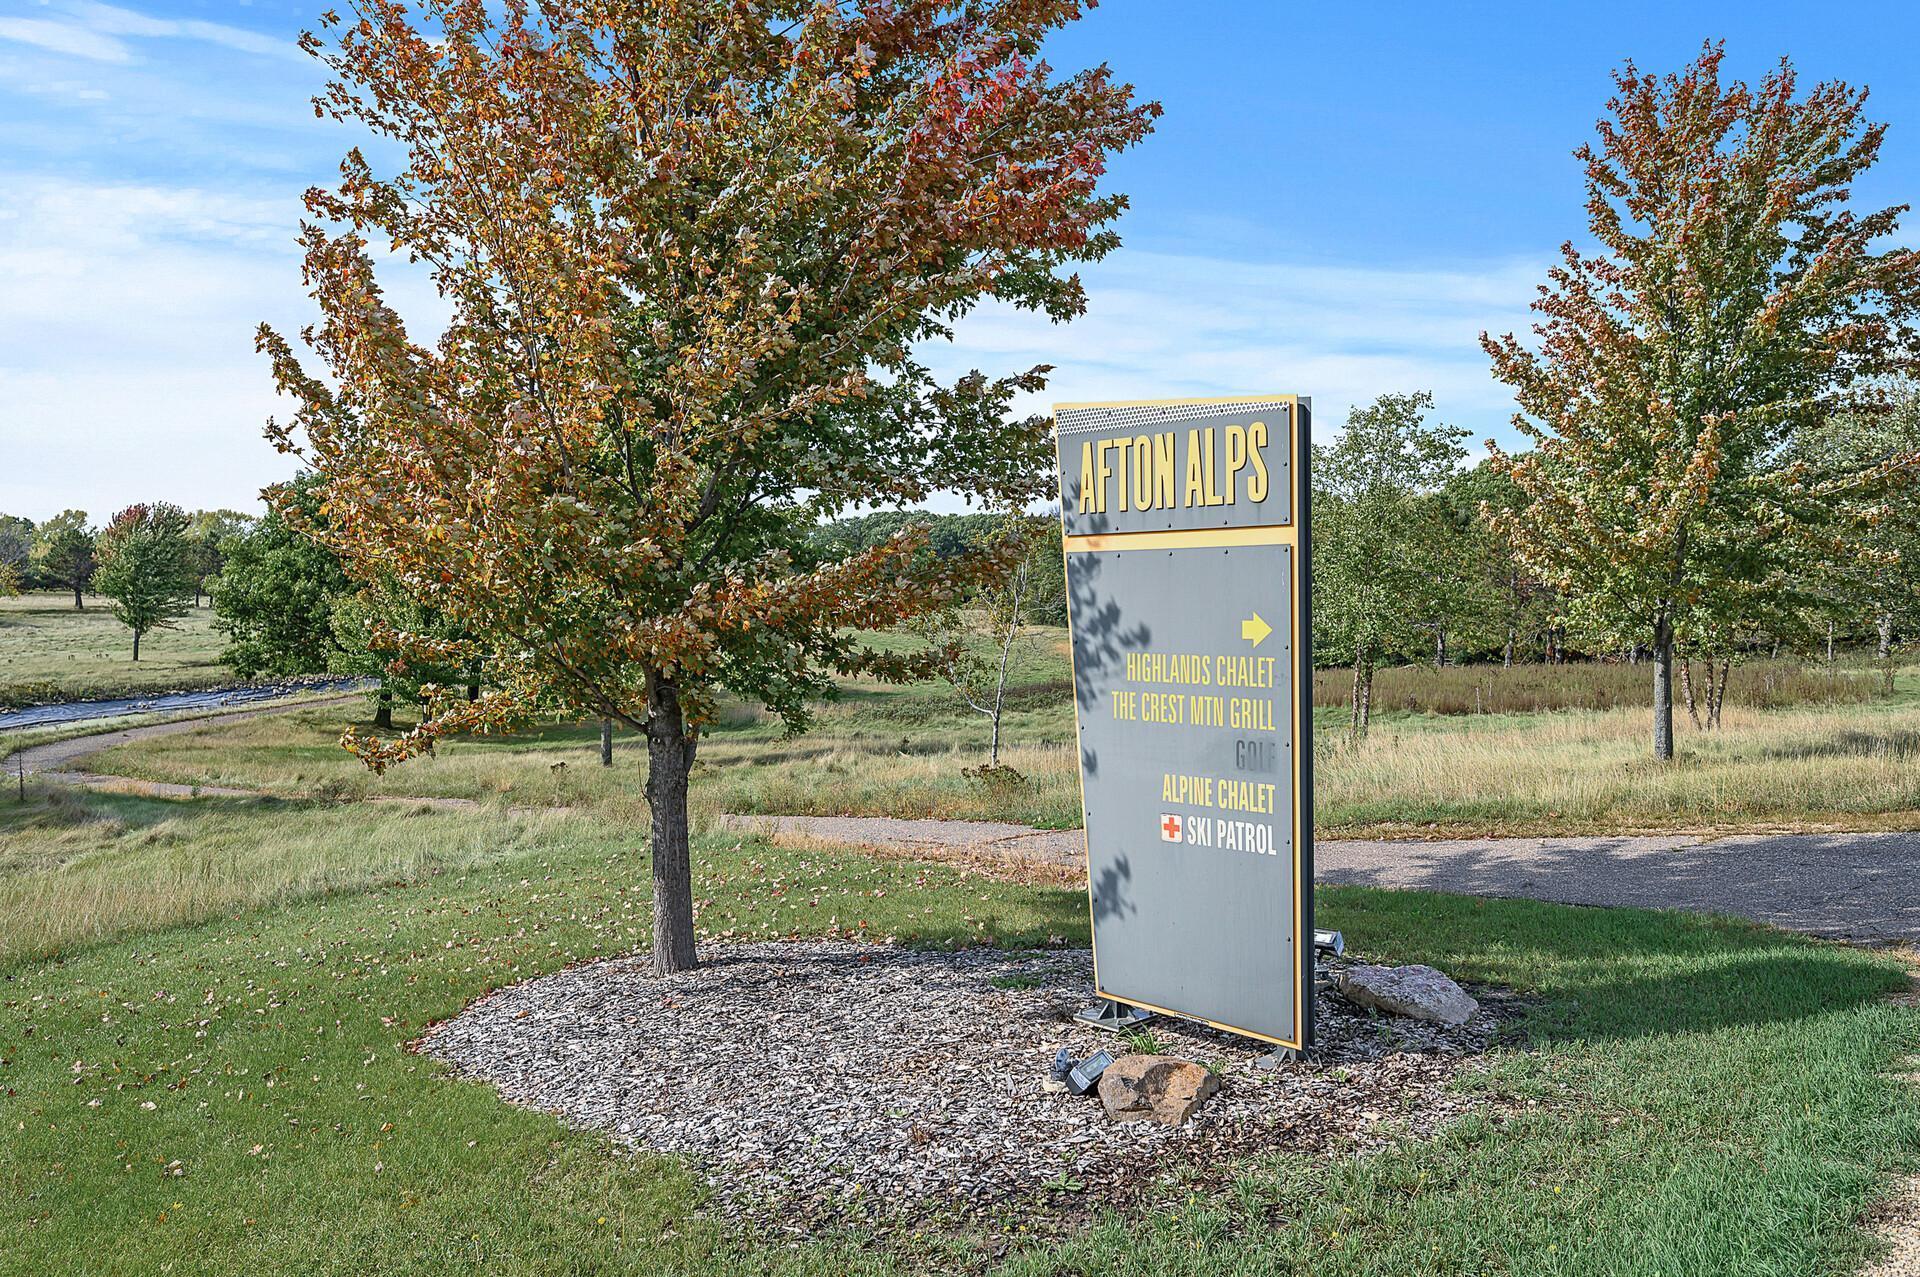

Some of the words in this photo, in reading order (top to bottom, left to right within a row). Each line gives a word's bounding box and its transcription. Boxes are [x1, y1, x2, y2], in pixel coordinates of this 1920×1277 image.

[1079, 431, 1176, 515] AFTON
[1184, 421, 1269, 508] ALPS
[1127, 652, 1211, 686] HIGHLANDS
[1216, 655, 1275, 688] CHALET
[1111, 691, 1137, 720] THE
[1141, 692, 1184, 724] CREST
[1190, 695, 1224, 727] MTN
[1230, 698, 1276, 731] GRILL
[1162, 774, 1213, 808] ALPINE
[1218, 779, 1275, 814] CHALET
[1187, 815, 1212, 847] SKI
[1217, 819, 1277, 856] PATROL
